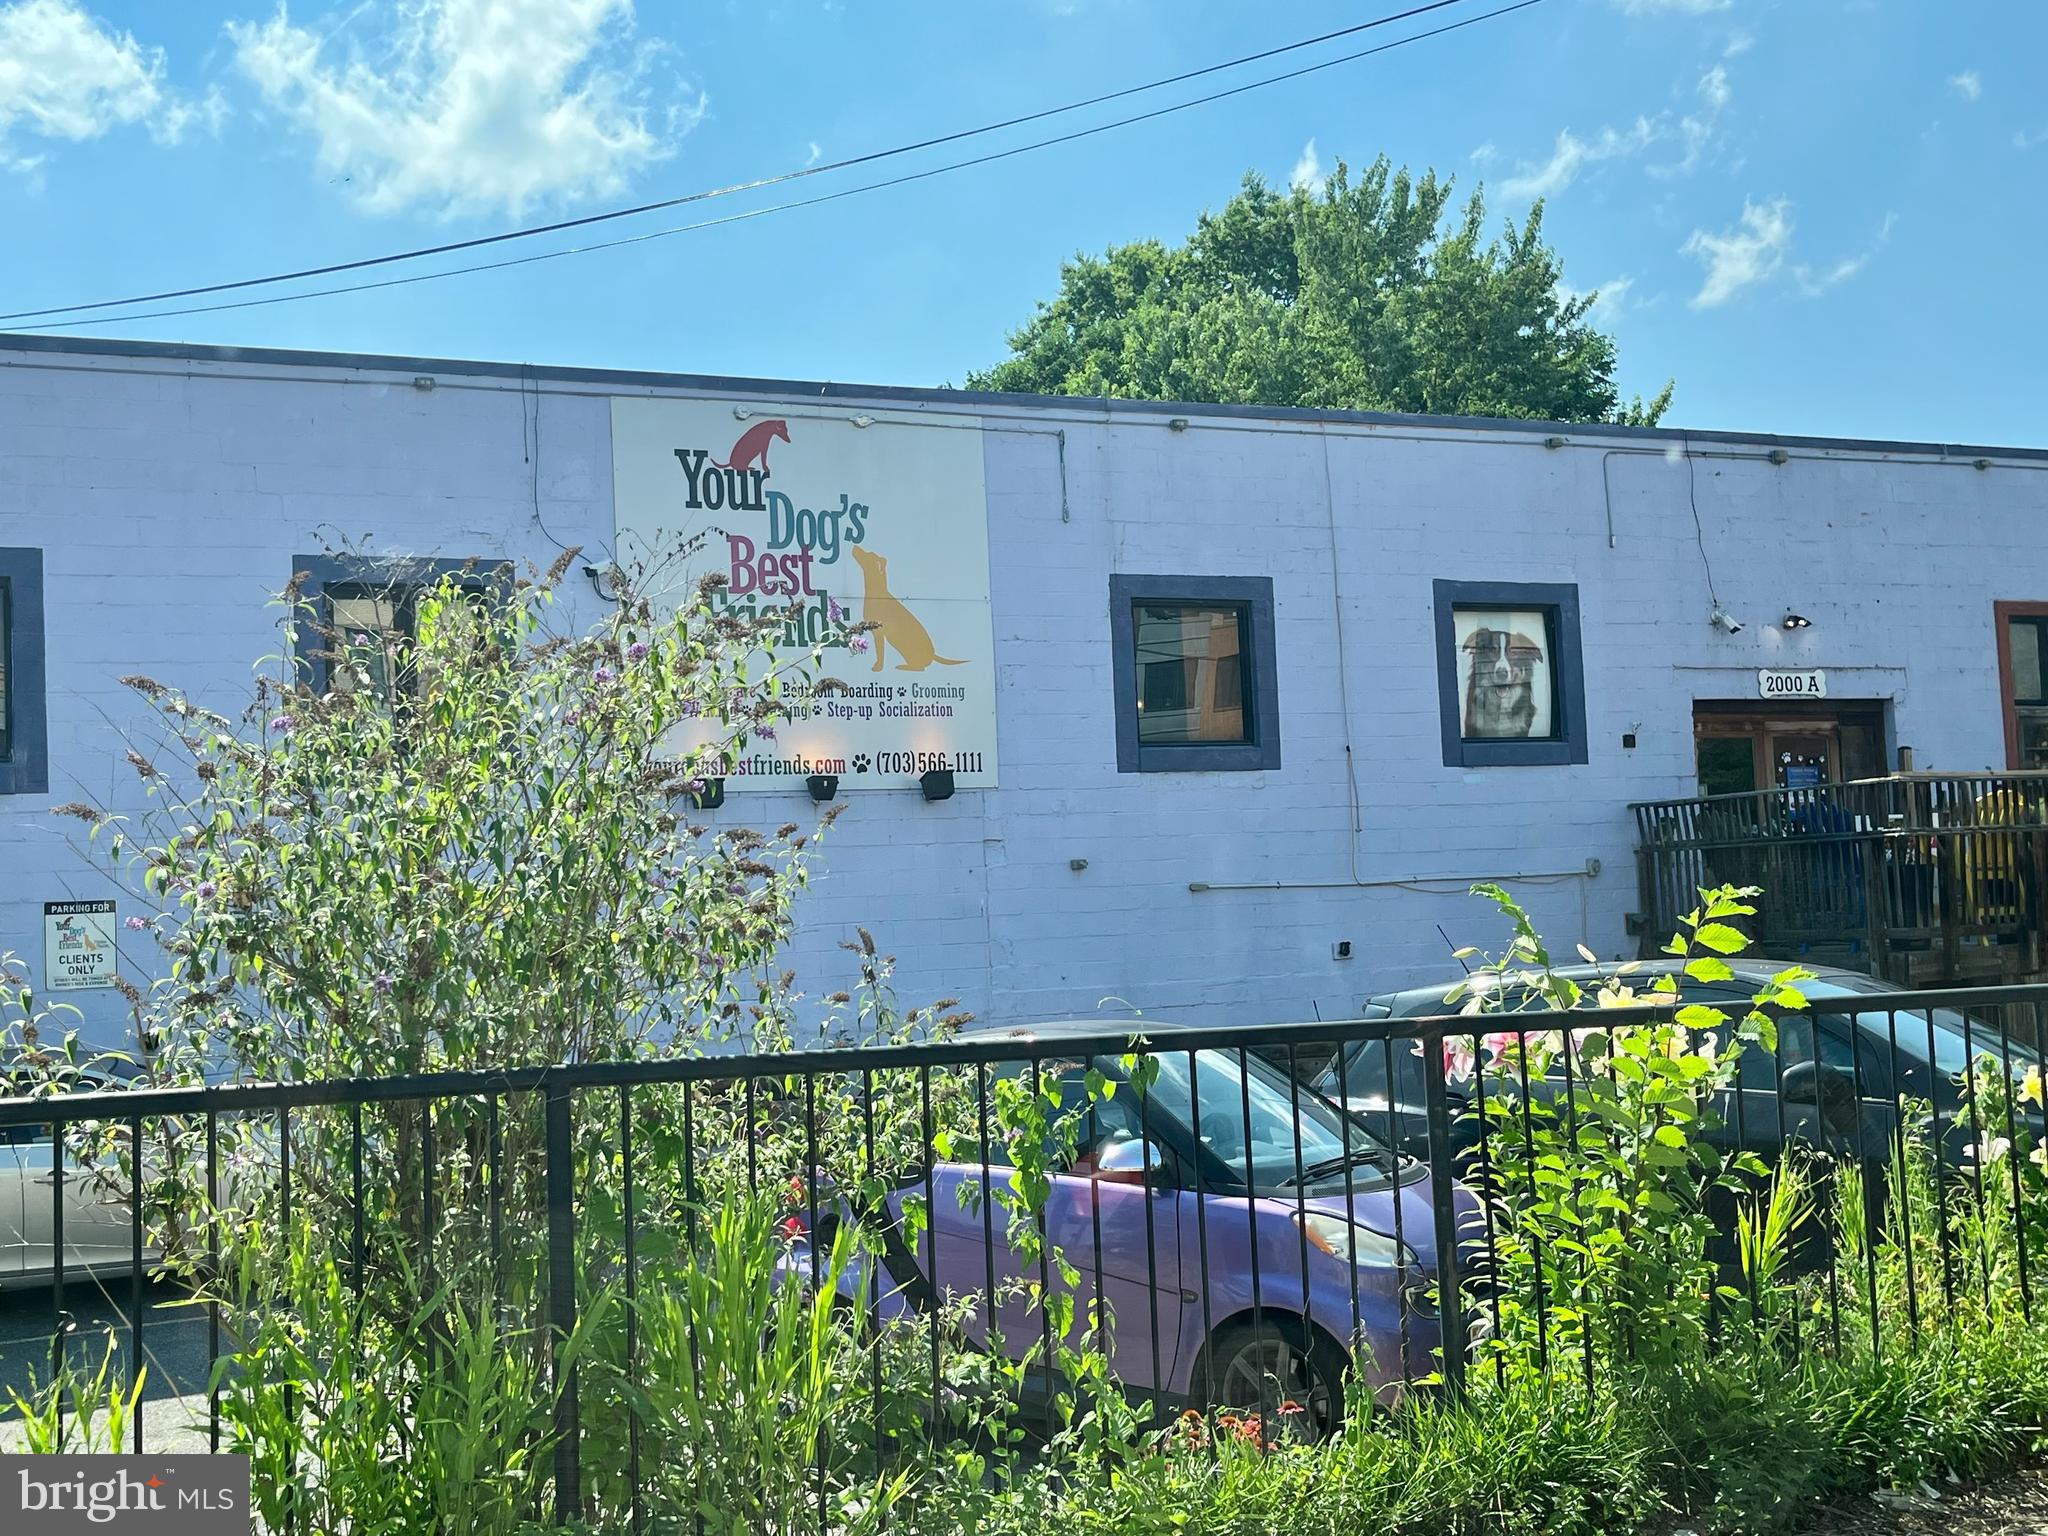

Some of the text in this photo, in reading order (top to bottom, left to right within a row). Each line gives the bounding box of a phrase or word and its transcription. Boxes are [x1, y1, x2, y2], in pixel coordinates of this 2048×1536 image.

[674, 448, 770, 511] Your
[765, 490, 869, 565] Dog's
[726, 534, 816, 596] Best
[840, 683, 893, 699] Boarding
[911, 683, 965, 700] Grooming
[1766, 676, 1820, 692] 2000 A
[828, 701, 873, 719] Step-up
[879, 701, 953, 717] Socialization
[51, 903, 110, 914] PARKING FOR
[58, 953, 104, 965] CLIENTS
[67, 965, 95, 975] ONLY
